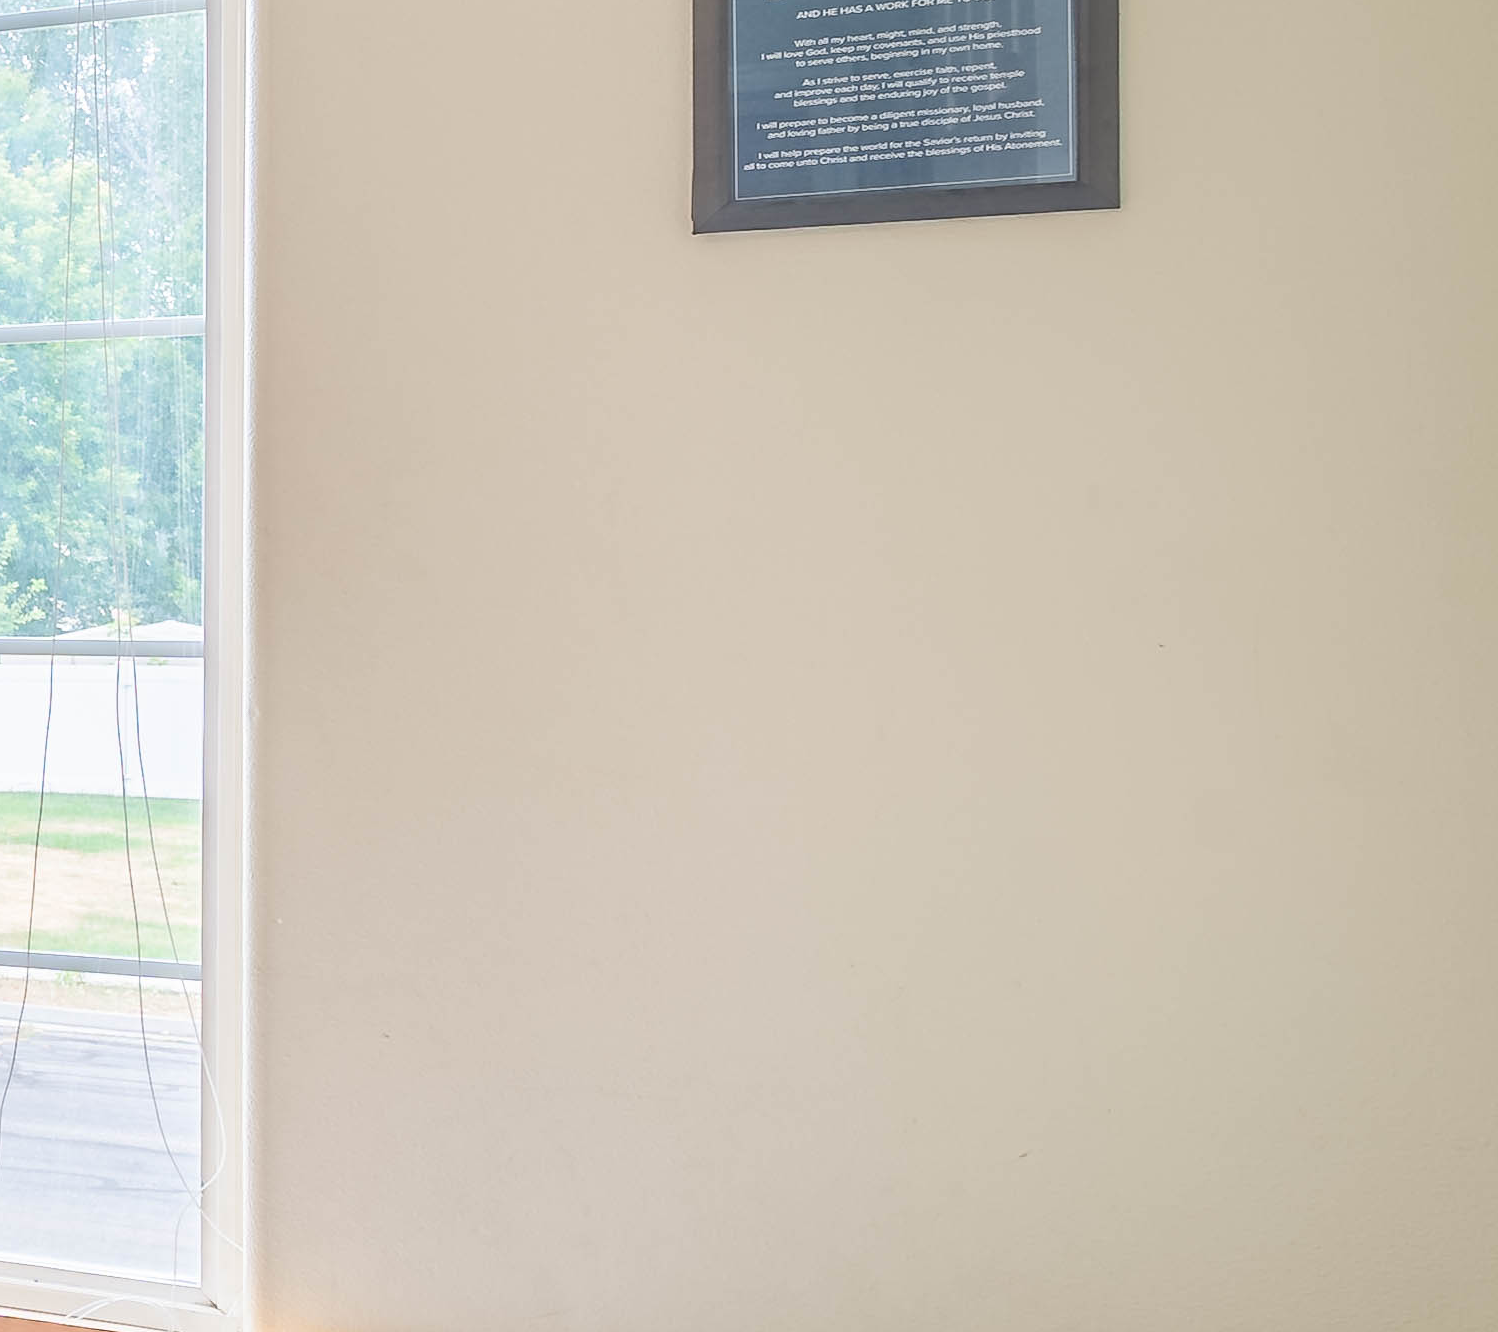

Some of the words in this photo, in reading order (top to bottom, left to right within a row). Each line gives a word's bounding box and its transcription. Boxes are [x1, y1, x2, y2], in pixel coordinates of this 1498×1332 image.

[795, 9, 821, 20] AND
[821, 7, 838, 17] HE
[839, 4, 863, 15] HAS
[864, 3, 874, 13] A
[875, 0, 909, 12] WORK
[760, 52, 764, 61] I
[766, 51, 782, 60] will
[783, 49, 804, 58] love
[829, 44, 855, 56] keep
[855, 43, 871, 53] my
[926, 34, 946, 44] and
[947, 34, 967, 42] use
[968, 31, 985, 40] His
[986, 25, 1041, 40] priesthood
[793, 37, 816, 47] With
[817, 36, 829, 45] all
[830, 36, 845, 45] my
[936, 23, 956, 33] and
[794, 59, 805, 67] to
[806, 57, 833, 66] serve
[870, 48, 919, 62] beginning
[920, 47, 930, 55] in
[931, 46, 948, 56] my
[948, 44, 971, 53] own
[773, 90, 792, 99] and
[793, 86, 833, 99] improve
[833, 84, 858, 93] each
[881, 81, 885, 89] I
[886, 79, 903, 89] will
[904, 76, 937, 88] qualify
[938, 75, 949, 84] to
[950, 72, 988, 83] receive
[989, 68, 1025, 81] temple
[801, 77, 815, 87] As
[816, 77, 820, 85] I
[821, 74, 849, 85] strive
[849, 73, 860, 82] to
[892, 66, 934, 78] exercise
[793, 95, 838, 109] blessings
[838, 94, 858, 103] and
[859, 92, 876, 101] the
[877, 88, 921, 101] enduring
[922, 88, 938, 97] joy
[939, 85, 950, 94] of
[951, 84, 968, 93] the
[756, 122, 760, 130] I
[761, 120, 777, 129] will
[778, 118, 816, 130] prepare
[817, 116, 828, 125] to
[829, 112, 869, 124] become
[878, 108, 915, 121] diligent
[972, 101, 996, 113] loyal
[766, 130, 786, 139] and
[786, 127, 816, 139] loving
[817, 125, 846, 135] father
[846, 123, 860, 134] by
[861, 121, 889, 133] being
[890, 121, 898, 129] a
[899, 118, 919, 128] true
[920, 115, 959, 128] disciple
[959, 114, 972, 123] of
[972, 111, 1002, 122] Jesus
[743, 162, 755, 171] all
[756, 161, 766, 170] to
[767, 160, 795, 169] come
[795, 157, 818, 167] unto
[819, 155, 847, 165] Christ
[848, 153, 868, 163] and
[869, 150, 905, 161] receive
[906, 149, 924, 158] the
[925, 145, 972, 158] blessings
[972, 144, 984, 153] of
[985, 142, 1003, 152] His
[757, 152, 762, 160] I
[762, 150, 779, 159] will
[780, 148, 802, 159] help
[803, 146, 841, 158] prepare
[842, 144, 859, 153] the
[860, 141, 888, 152] world
[889, 140, 902, 149] for
[904, 139, 921, 148] the
[963, 133, 993, 143] return
[994, 132, 1008, 142] by
[1009, 128, 1046, 141] inviting
